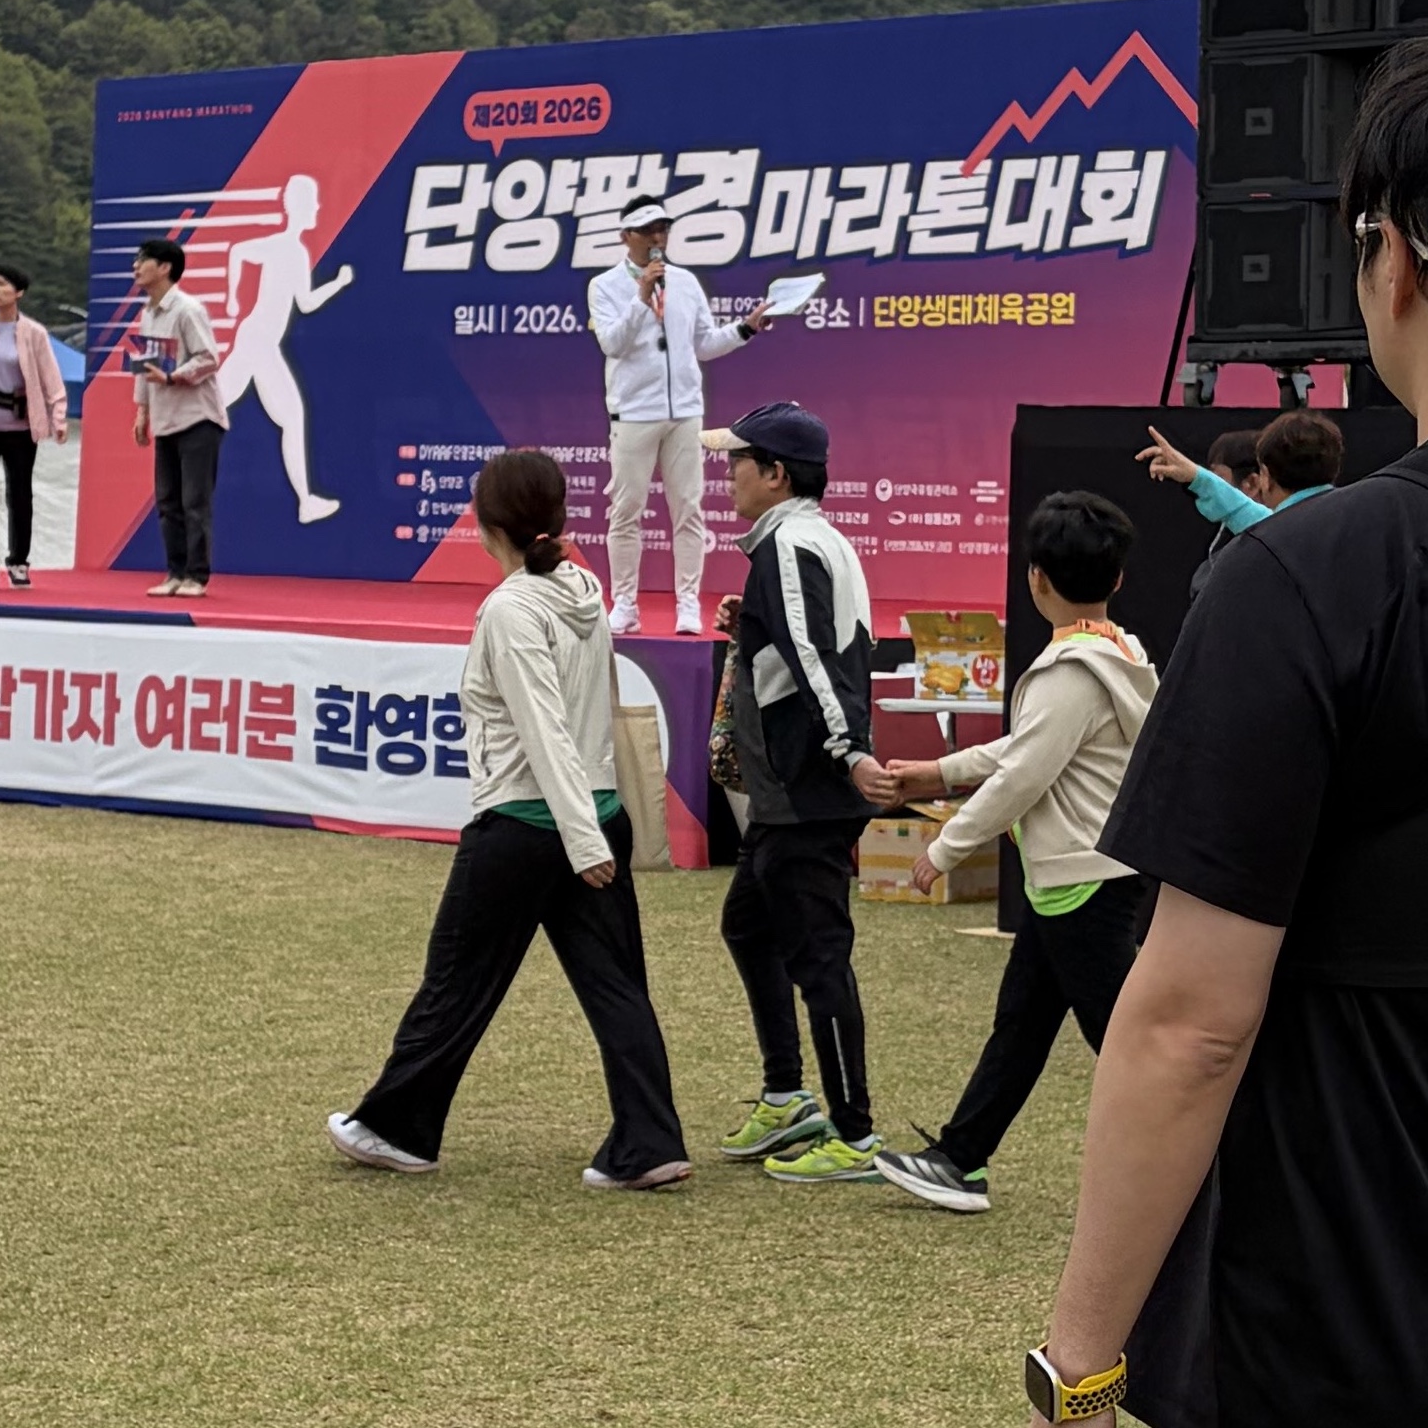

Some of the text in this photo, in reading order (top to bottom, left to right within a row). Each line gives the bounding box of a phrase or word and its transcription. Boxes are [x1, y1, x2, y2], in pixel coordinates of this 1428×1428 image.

[472, 95, 603, 130] 제20회 2026
[453, 306, 498, 336] 일시
[804, 292, 1077, 329] 장소 단양생태체육공원
[134, 674, 298, 762] 여러분
